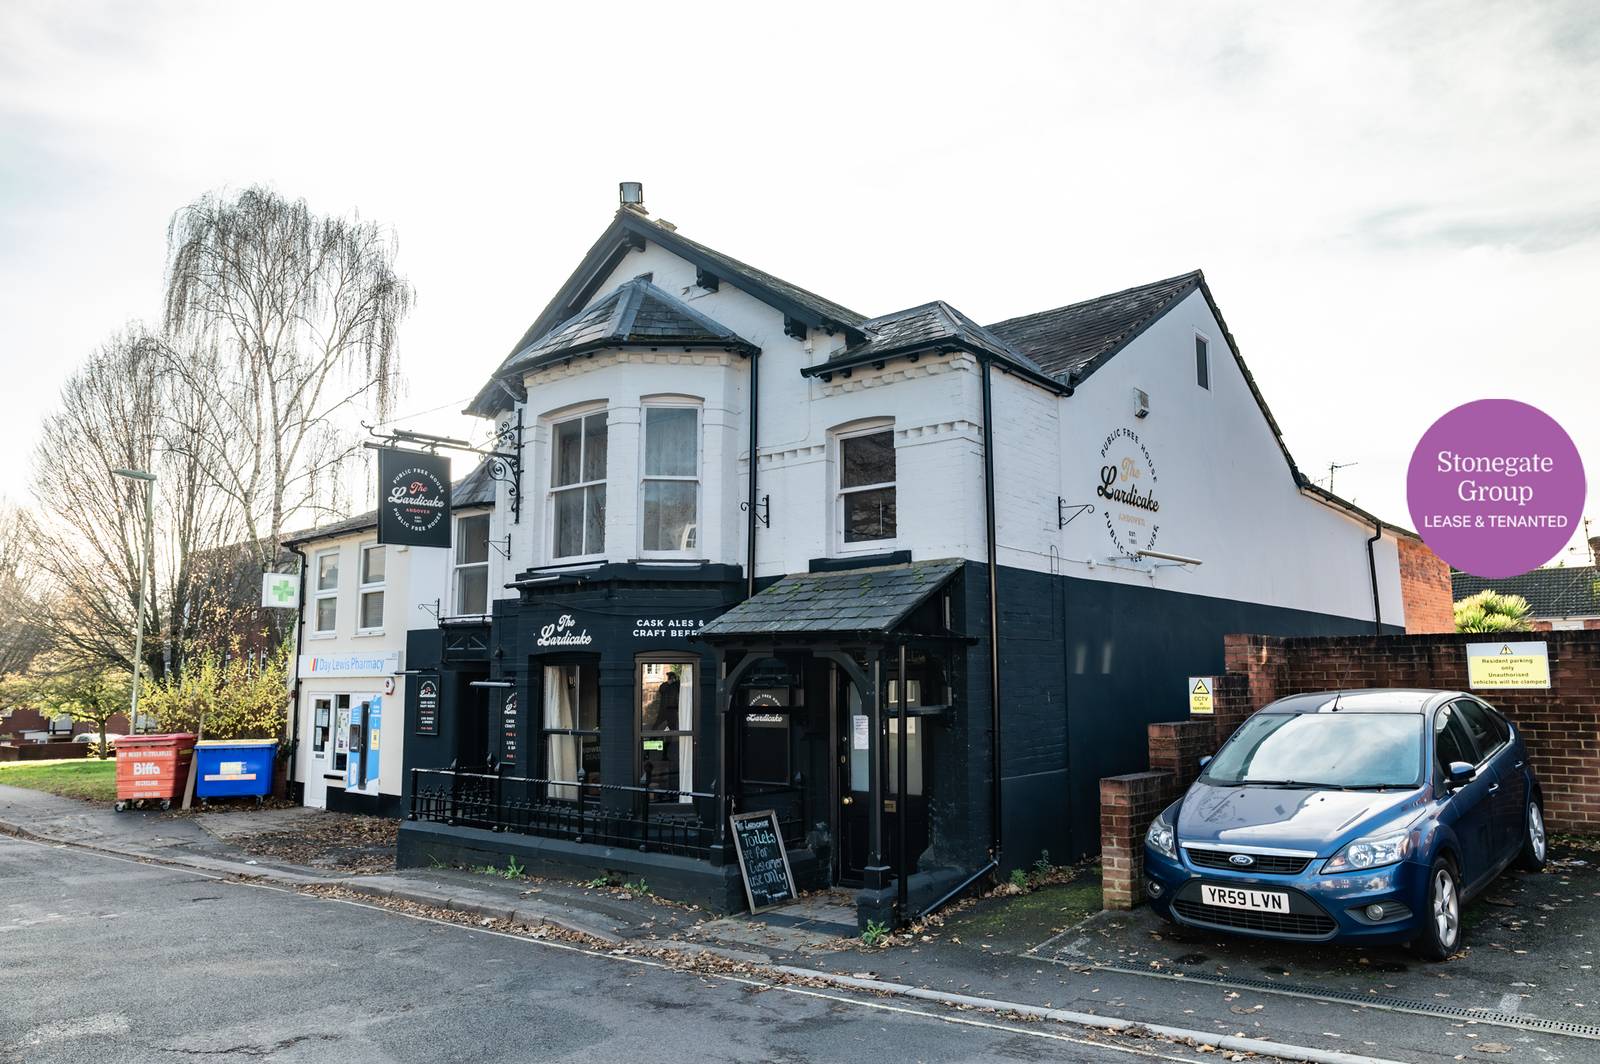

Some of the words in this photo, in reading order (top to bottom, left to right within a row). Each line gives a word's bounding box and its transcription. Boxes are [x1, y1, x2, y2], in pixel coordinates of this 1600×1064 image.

[1101, 428, 1120, 458] PUBLIC
[1123, 428, 1139, 444] FREE
[1141, 443, 1157, 483] HOUSE
[1120, 457, 1140, 482] The
[393, 469, 411, 484] PUBLIC
[413, 468, 428, 476] FREE
[430, 474, 445, 493] HOUSE
[410, 481, 428, 494] The
[1097, 465, 1159, 512] Lardicake
[387, 486, 444, 508] Lardicake
[393, 508, 410, 528] PUBLIC
[427, 512, 443, 529] HOUSE
[1104, 511, 1124, 554] PUBLIC
[557, 614, 575, 632] The
[632, 629, 666, 637] CRAFT
[670, 629, 702, 637] BEER
[636, 619, 664, 627] CASK
[668, 619, 694, 627] ALES
[698, 619, 704, 627] &
[537, 623, 592, 646] Lardicake
[320, 659, 331, 672] Day
[333, 658, 350, 671] Lewis
[351, 656, 385, 672] Pharmacy
[133, 762, 160, 776] Biffa
[741, 829, 776, 847] Toilets
[755, 846, 769, 859] for
[749, 874, 763, 888] use
[763, 869, 788, 890] only
[1208, 887, 1247, 906] YR59
[1250, 892, 1282, 910] LVN
